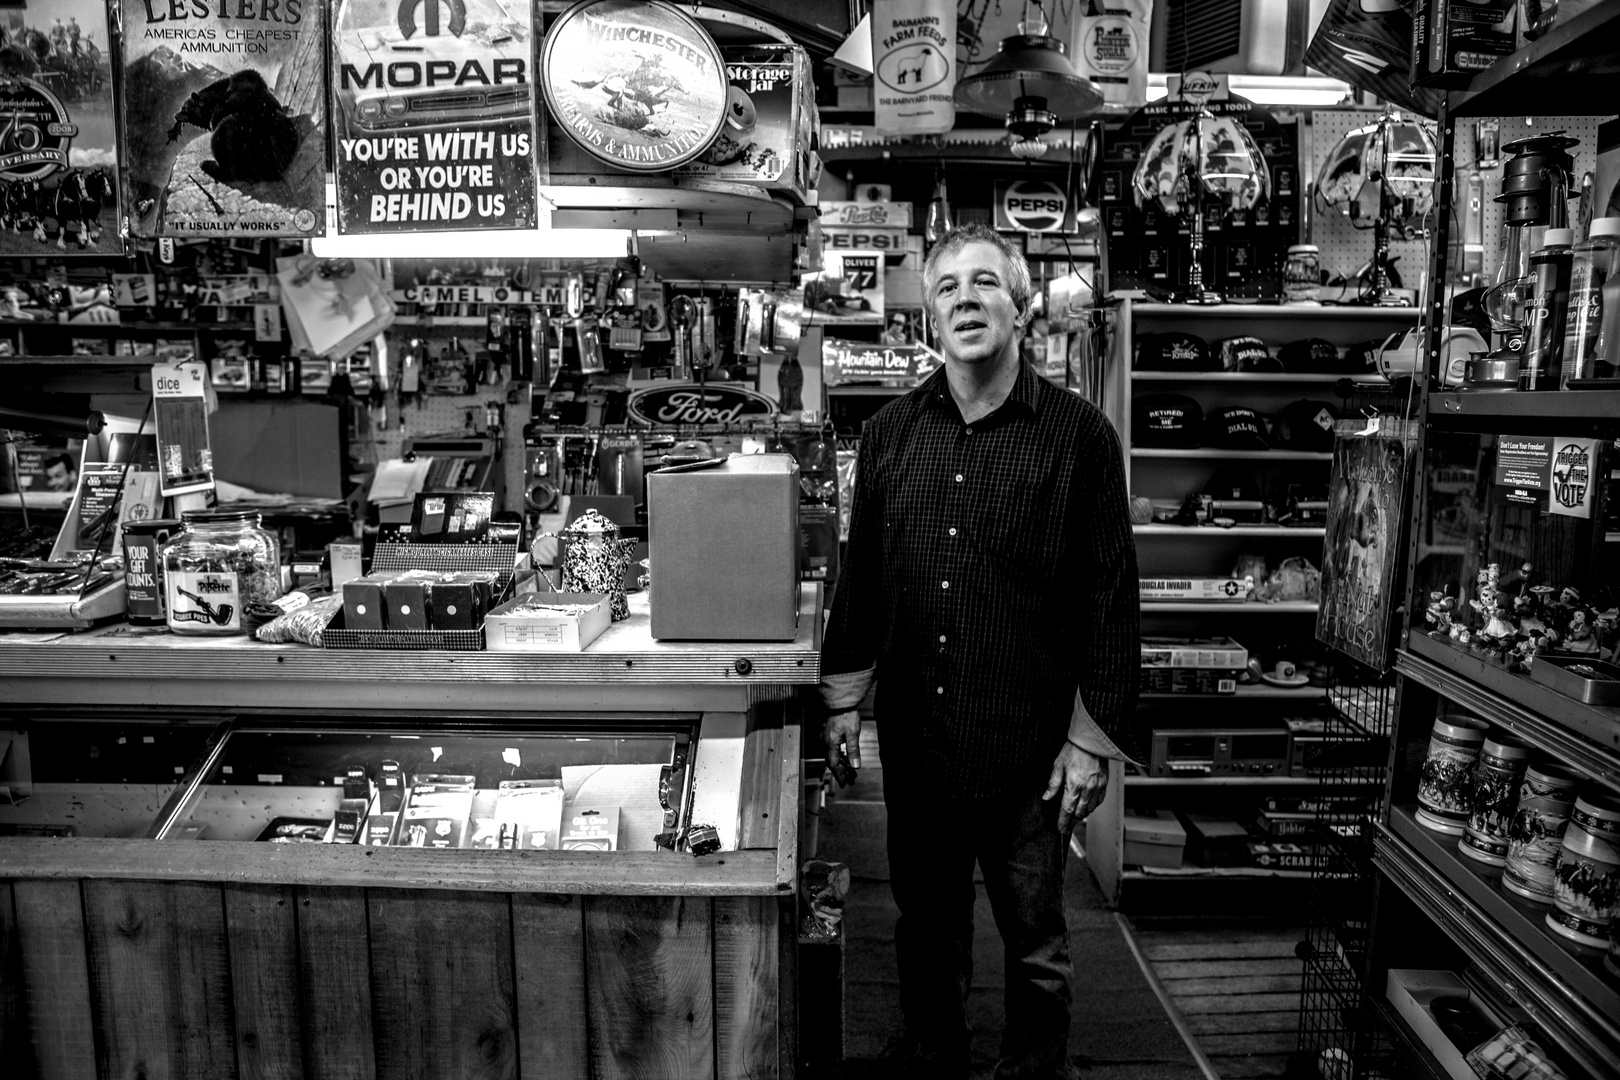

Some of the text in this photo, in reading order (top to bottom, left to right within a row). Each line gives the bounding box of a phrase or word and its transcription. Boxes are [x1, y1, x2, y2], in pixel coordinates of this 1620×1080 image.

[144, 0, 301, 24] LESTERS
[144, 28, 301, 41] AMERICA'S CHEAPEST
[883, 26, 947, 49] FARM FEEDS
[179, 42, 269, 53] AMMUNITION
[585, 19, 706, 75] WINCHESTER
[340, 59, 527, 89] MOPAR
[725, 66, 790, 81] Storage
[1144, 106, 1169, 114] BASIC
[1225, 103, 1253, 112] TOOLS
[341, 132, 530, 161] YOU'RE WITH US
[618, 120, 709, 162] AMMUNITION
[380, 165, 493, 190] OR YOU'RE
[370, 190, 506, 222] BEHIND US
[1008, 199, 1064, 212] PEPSI
[188, 222, 236, 231] USUALLY
[822, 233, 900, 248] PEPSI
[846, 272, 874, 287] 77
[838, 350, 883, 368] Mountain
[883, 349, 909, 368] Dew
[156, 377, 180, 390] dice
[658, 392, 754, 424] Ford
[609, 439, 640, 448] GERBER
[1557, 452, 1589, 466] TRIGGER
[1571, 468, 1587, 482] THE
[1555, 482, 1584, 507] VOTE
[127, 545, 149, 560] YOUR
[130, 560, 146, 573] GIFT
[127, 573, 156, 587] COUNTS.
[1166, 581, 1192, 590] INVADER
